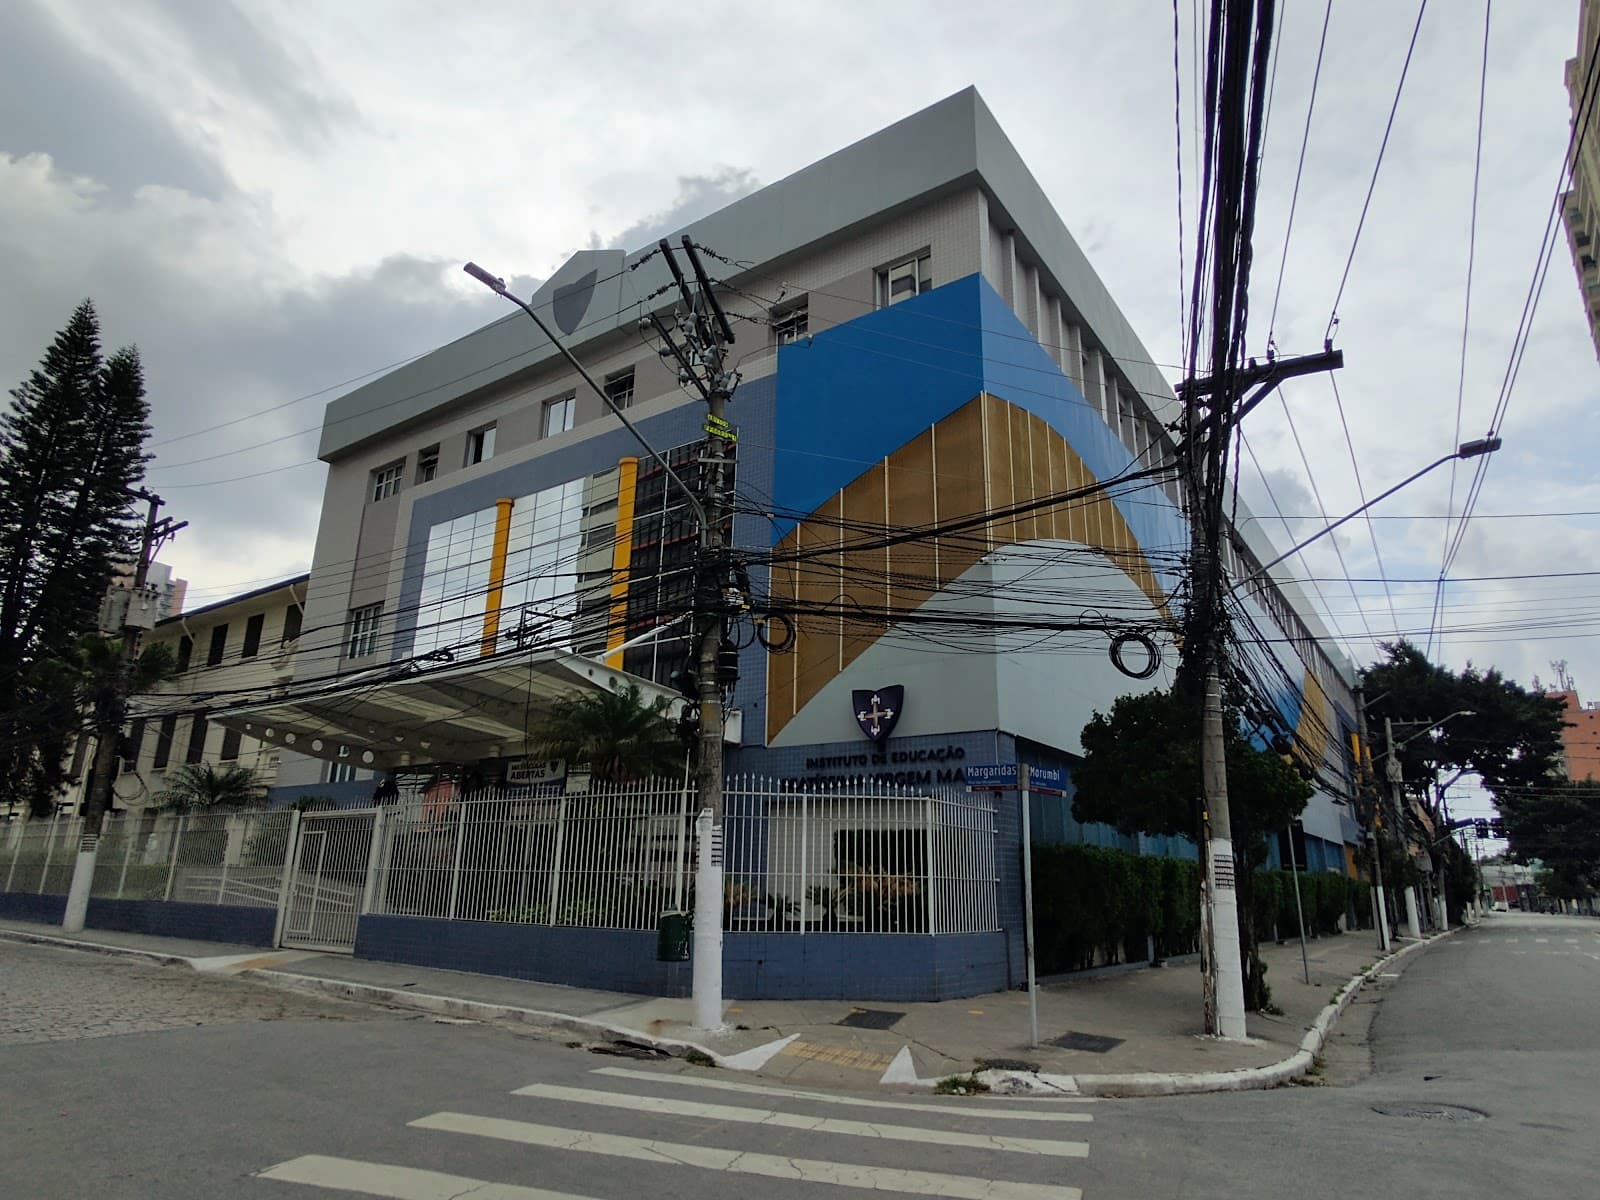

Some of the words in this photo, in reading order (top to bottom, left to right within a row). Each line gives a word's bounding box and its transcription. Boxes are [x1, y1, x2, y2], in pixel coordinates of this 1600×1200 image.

[806, 754, 867, 769] INSTITUTO
[872, 753, 887, 765] DE
[892, 745, 965, 764] EDUCAÇÃO
[510, 769, 545, 779] ABERTAS
[937, 767, 966, 784] MA
[967, 765, 1017, 779] Margaridas
[1029, 765, 1060, 781] Morumbi
